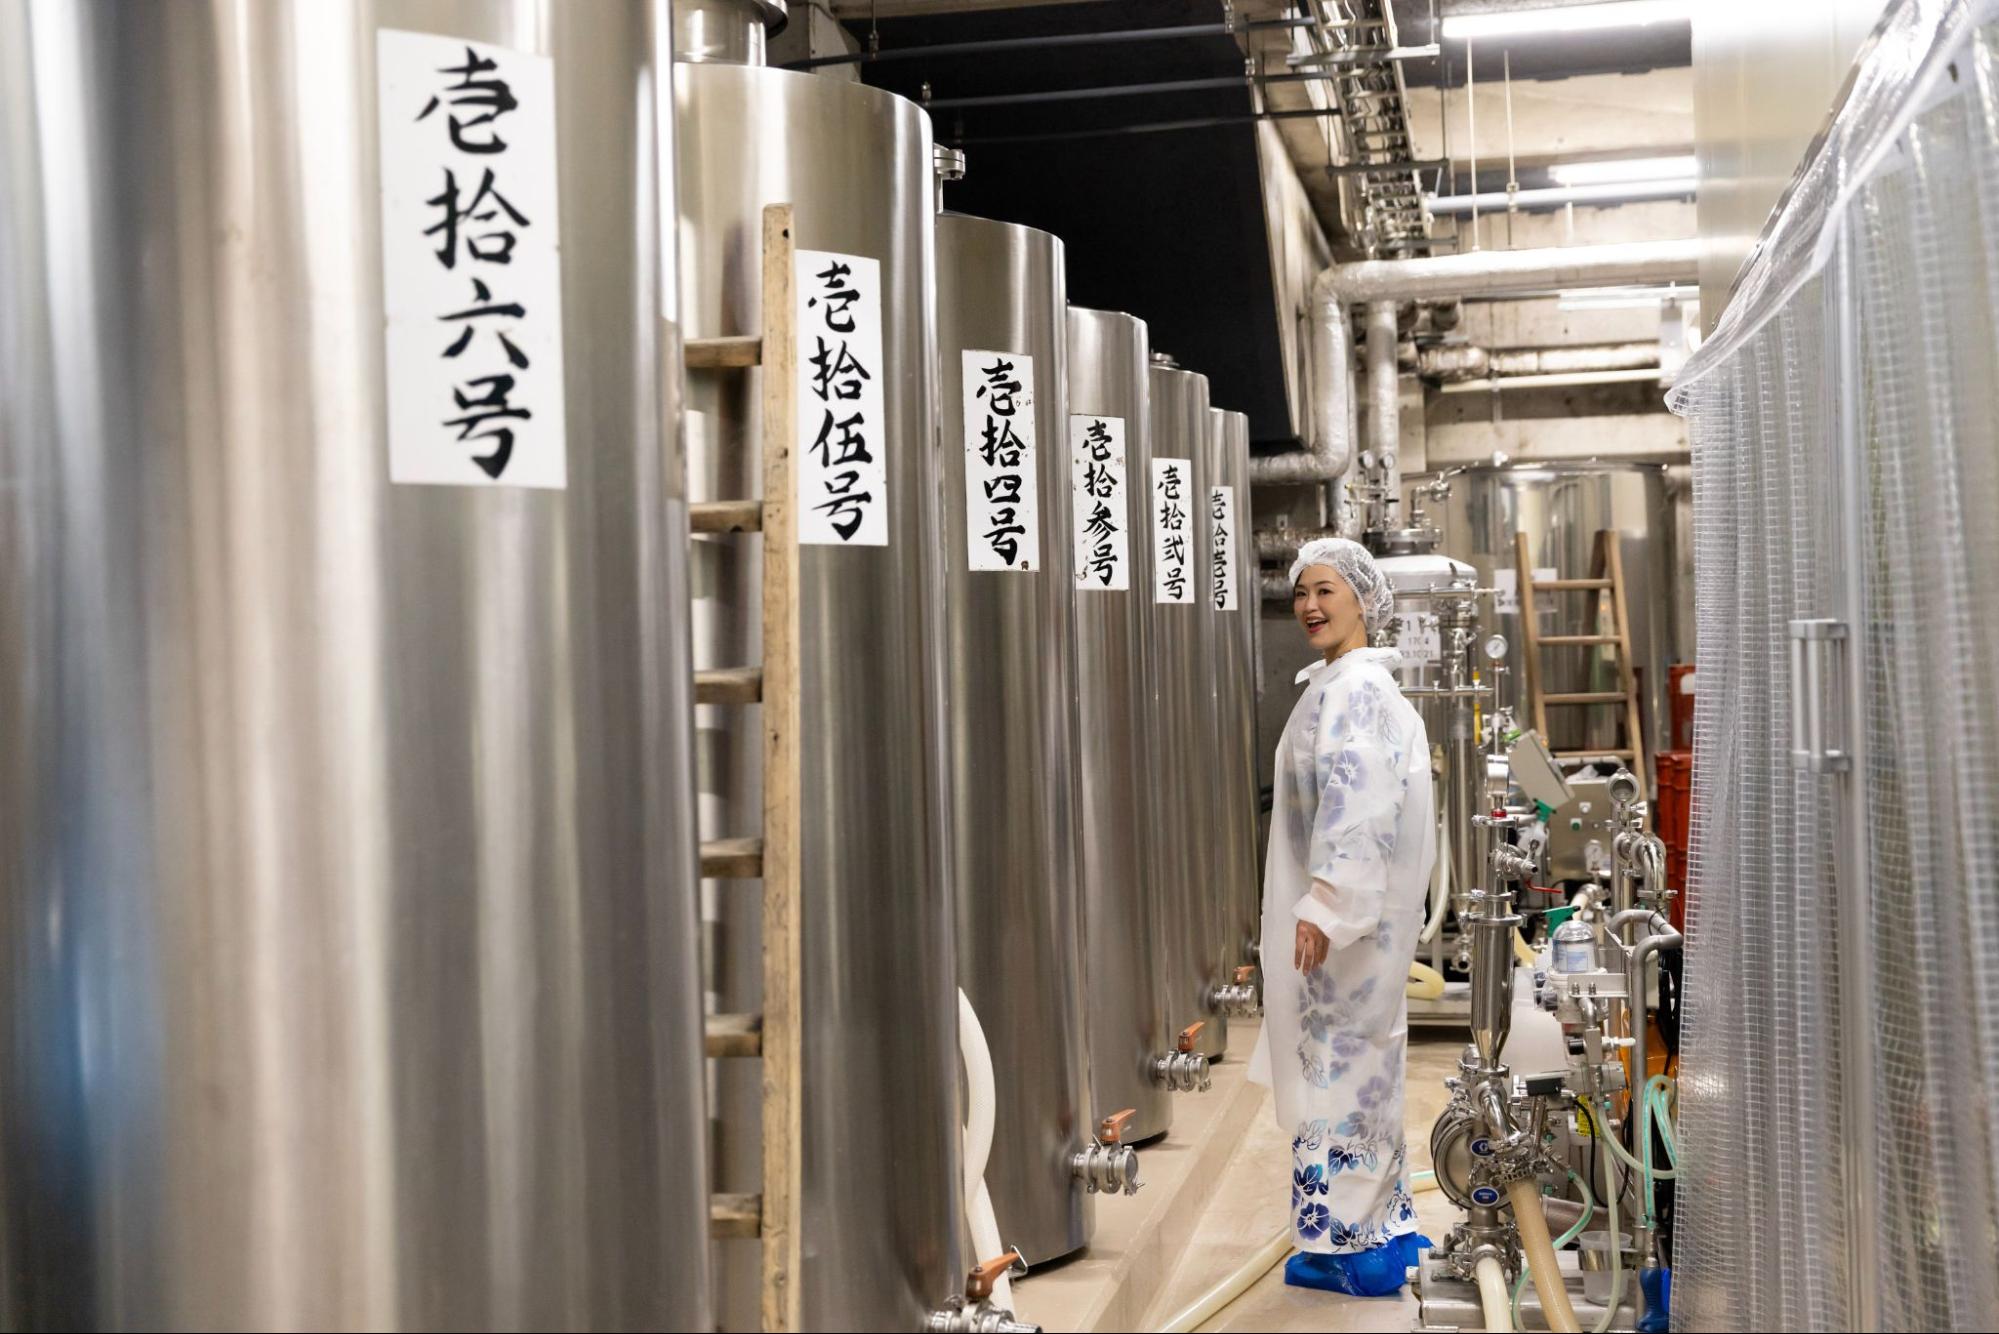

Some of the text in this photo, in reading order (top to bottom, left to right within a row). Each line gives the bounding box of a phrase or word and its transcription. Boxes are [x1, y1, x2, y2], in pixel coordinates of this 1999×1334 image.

[416, 47, 532, 479] 壱拾六号
[808, 260, 873, 542] 壱拾伍号
[976, 359, 1026, 566] 壱拾四号
[1082, 419, 1119, 586] 壱拾参号
